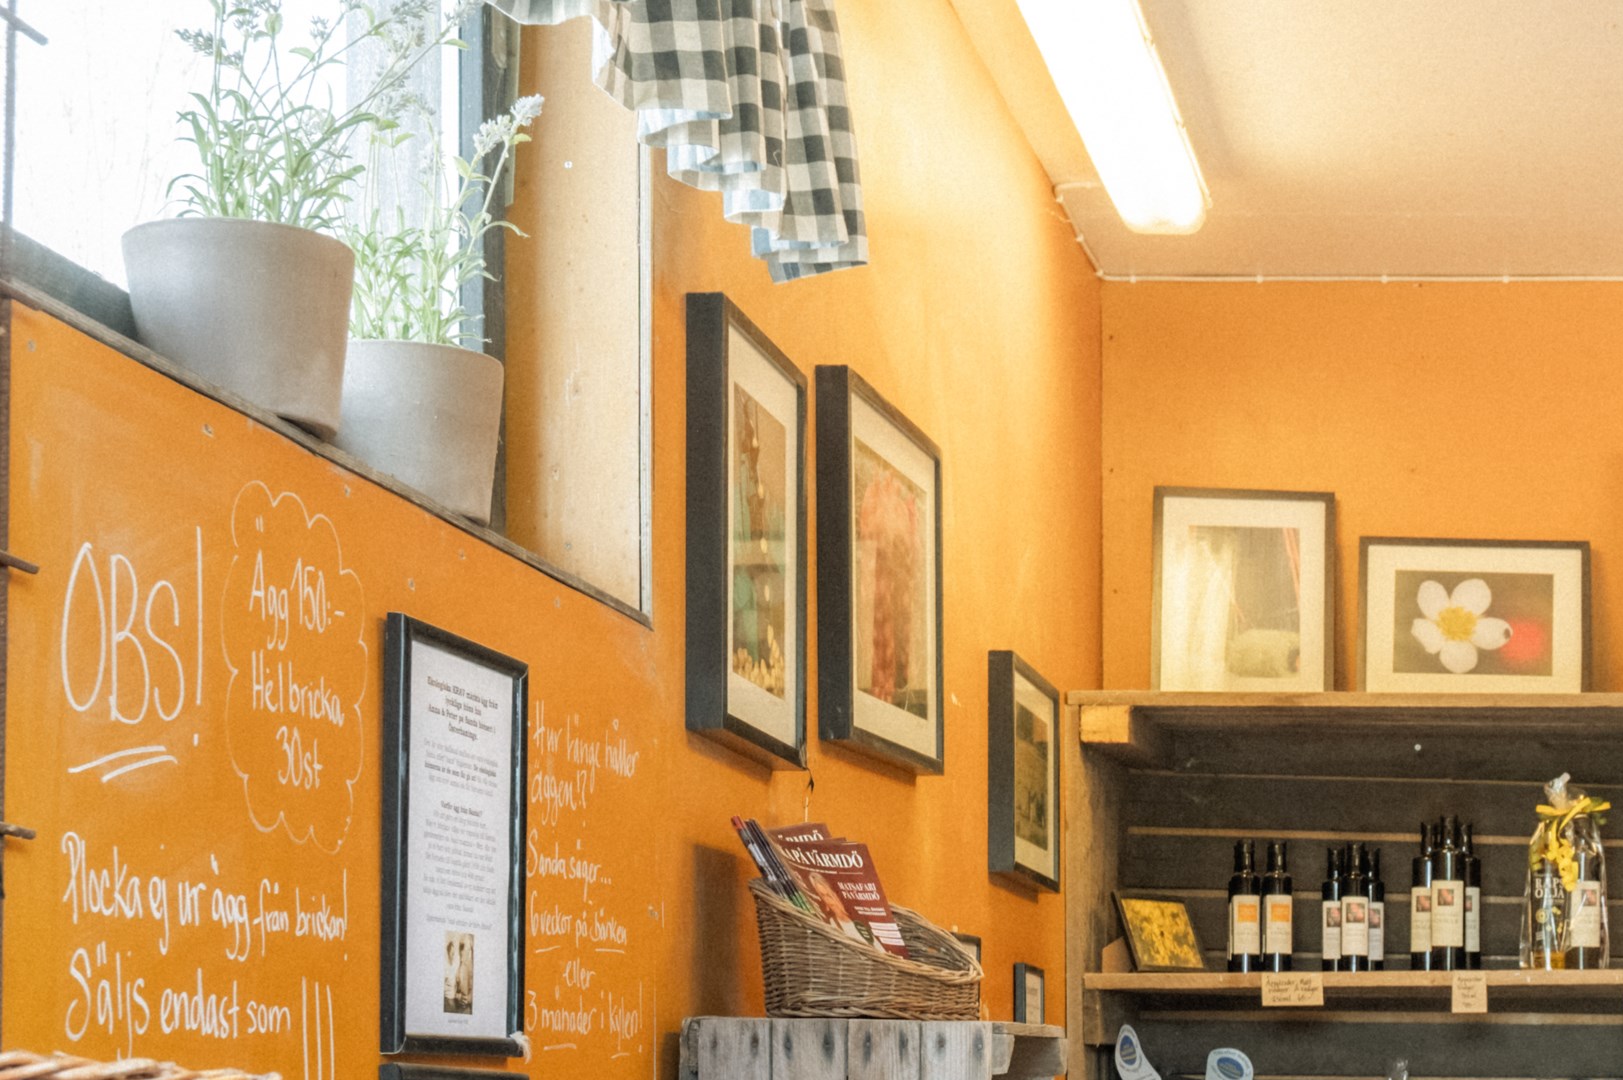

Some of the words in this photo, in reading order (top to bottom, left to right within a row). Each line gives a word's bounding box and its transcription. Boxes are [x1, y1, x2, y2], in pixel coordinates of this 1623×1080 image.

[249, 515, 290, 651] Ägg
[61, 525, 204, 747] OBS!
[287, 660, 345, 728] bricka
[533, 699, 563, 756] Hur
[805, 849, 864, 869] VÄRMDÖ
[61, 831, 143, 925] Plocka
[149, 844, 170, 956] ej
[211, 853, 251, 962] ägg
[252, 878, 289, 957] från
[540, 904, 573, 936] veckor
[575, 911, 588, 948] på
[65, 941, 151, 1061] Säljs
[160, 967, 240, 1039] endast
[246, 1001, 292, 1034] som
[563, 957, 597, 990] eller
[526, 990, 538, 1032] 3
[541, 984, 598, 1035] månader
